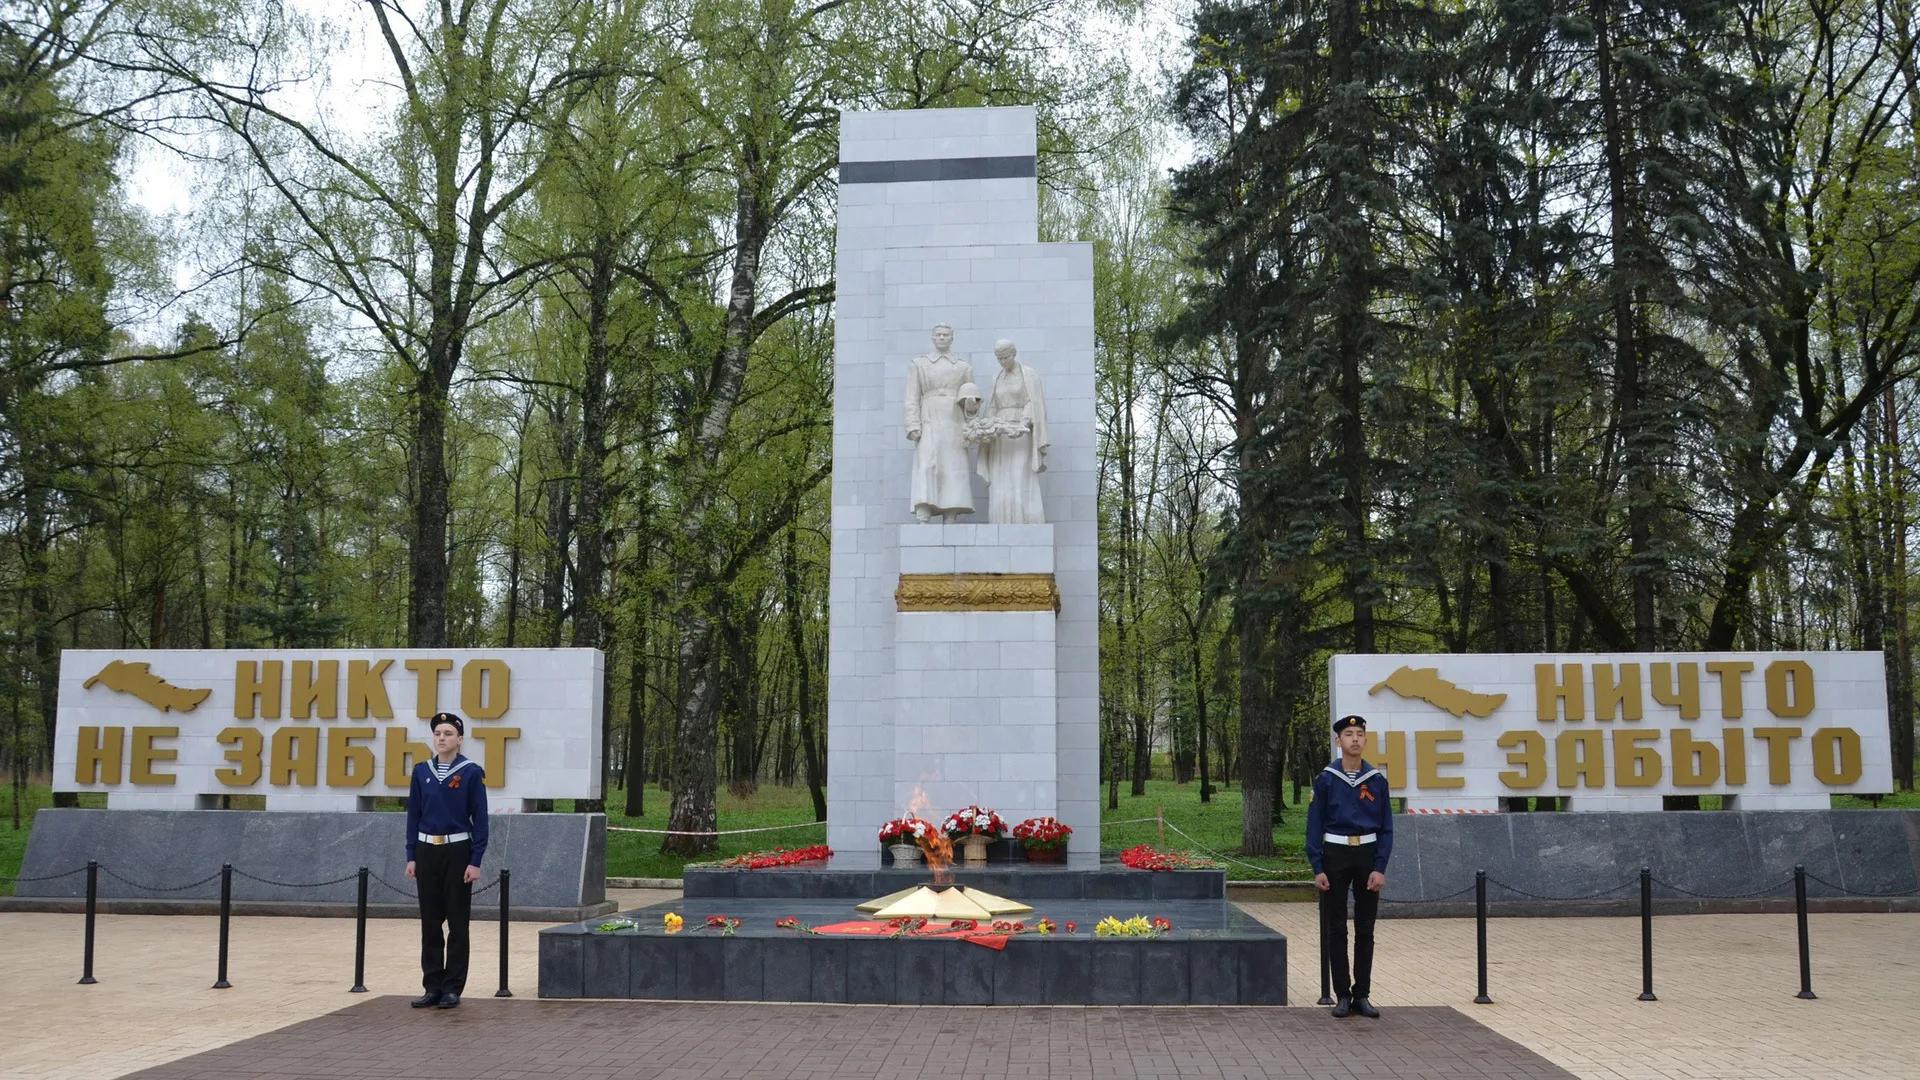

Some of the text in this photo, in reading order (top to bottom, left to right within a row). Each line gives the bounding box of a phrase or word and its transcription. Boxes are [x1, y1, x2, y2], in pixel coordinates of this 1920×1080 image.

[235, 659, 510, 719] НИКТО
[1535, 660, 1815, 721] НИЧТО
[75, 726, 179, 785] НЕ
[1363, 727, 1862, 789] НЕ ЗАБЫТО
